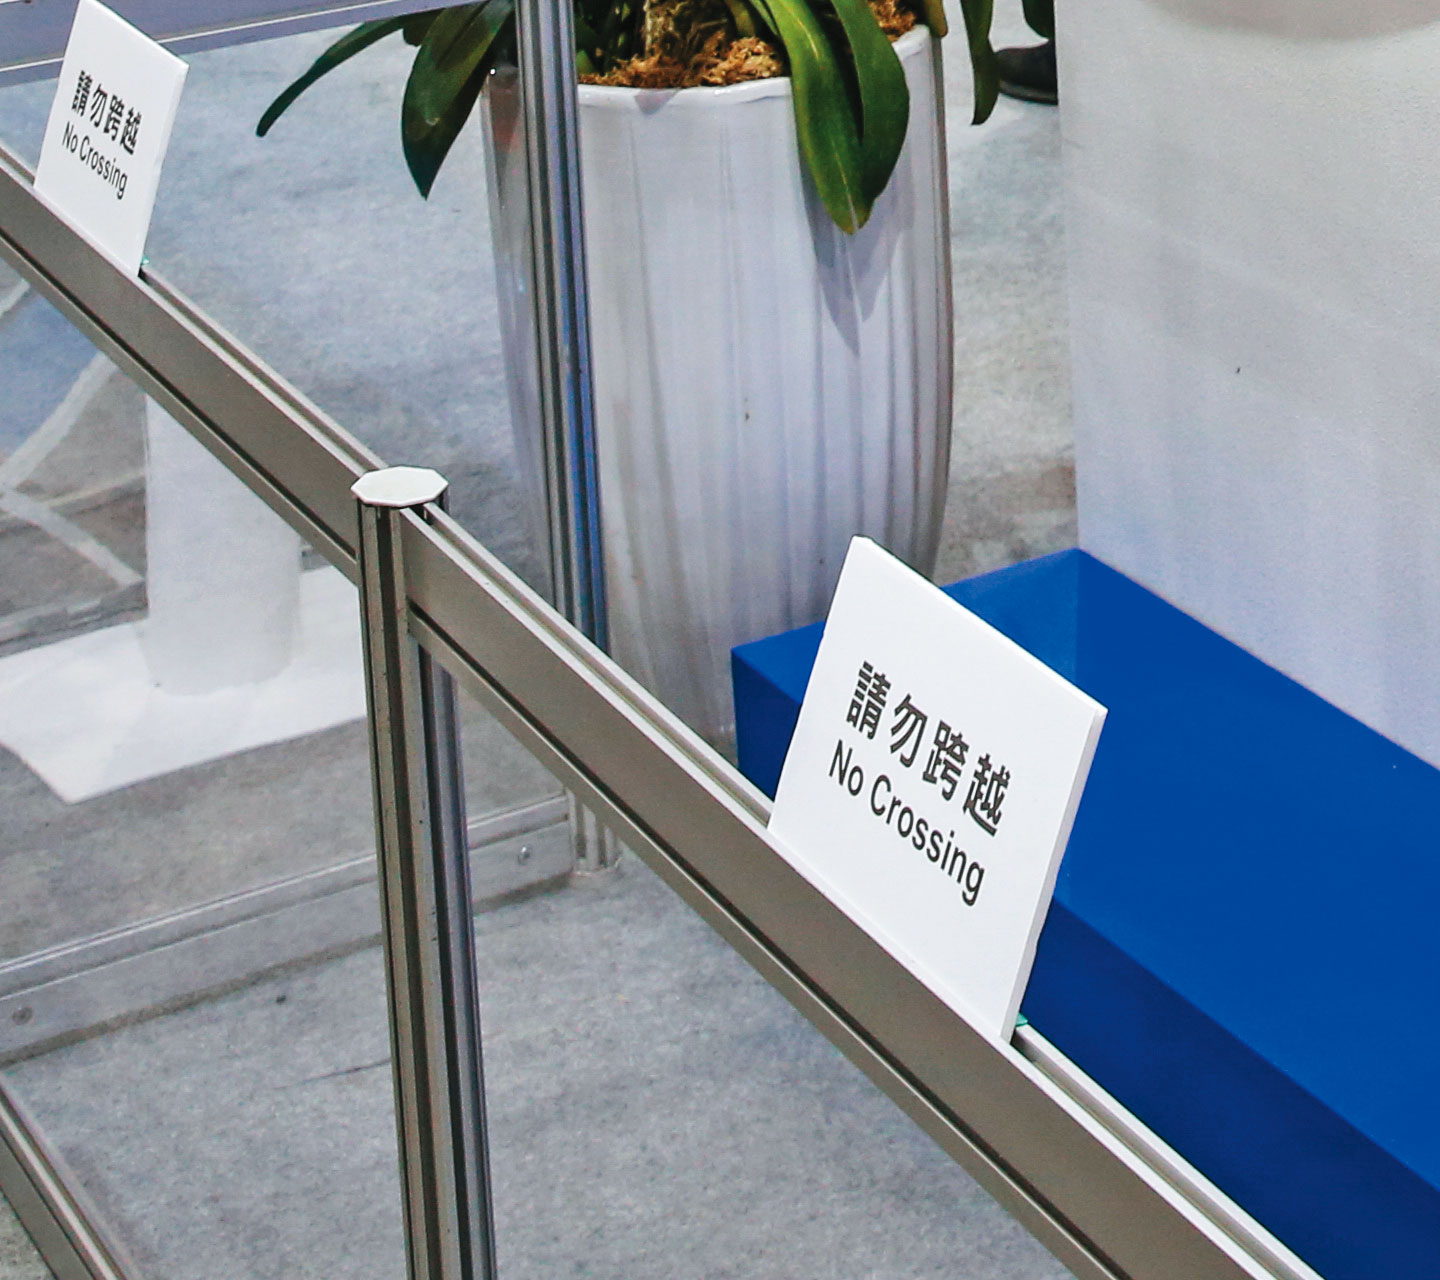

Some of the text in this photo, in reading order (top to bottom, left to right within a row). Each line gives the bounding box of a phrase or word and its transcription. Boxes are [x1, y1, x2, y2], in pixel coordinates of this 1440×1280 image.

[62, 120, 129, 201] No Crossing
[71, 69, 143, 156] 請勿跨越
[845, 660, 1011, 838] 請勿跨越
[828, 738, 985, 907] No Crossing
